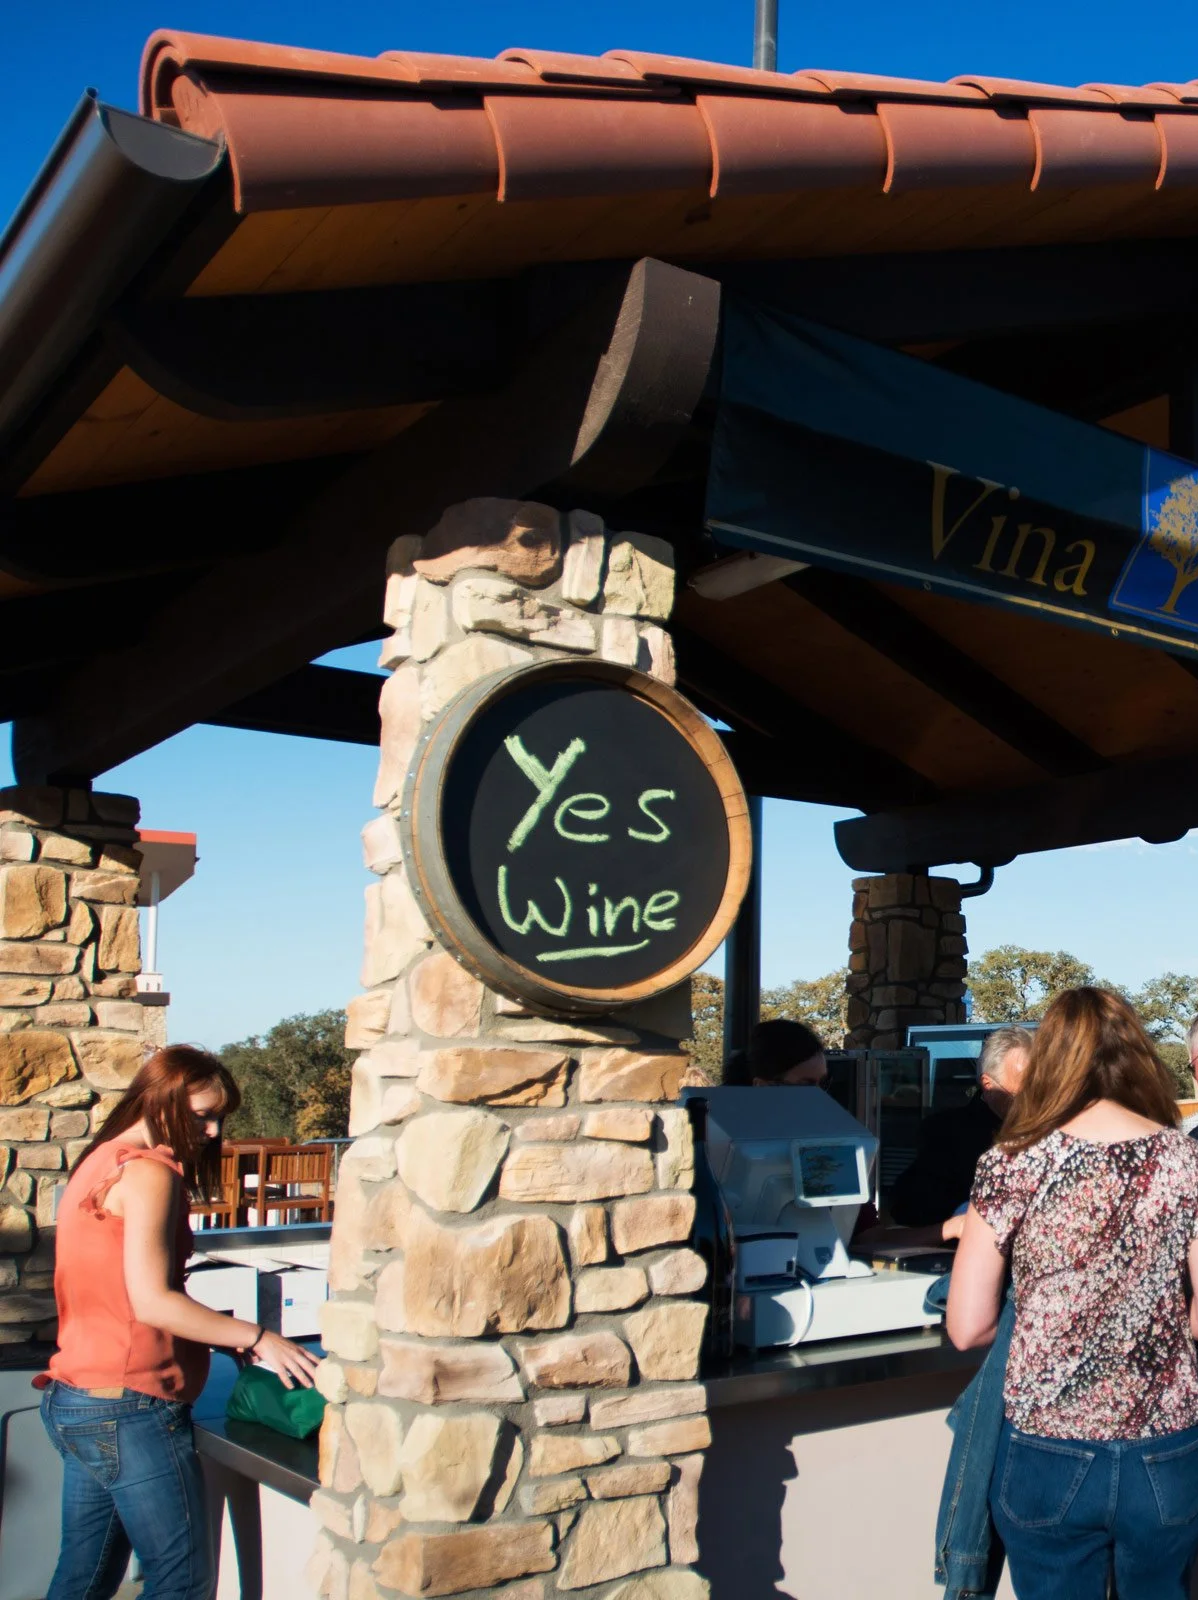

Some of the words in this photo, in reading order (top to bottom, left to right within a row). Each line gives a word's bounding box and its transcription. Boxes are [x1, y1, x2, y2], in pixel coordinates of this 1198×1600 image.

[926, 460, 1096, 596] Vina
[503, 734, 675, 852] Yes
[497, 865, 680, 937] Wine
